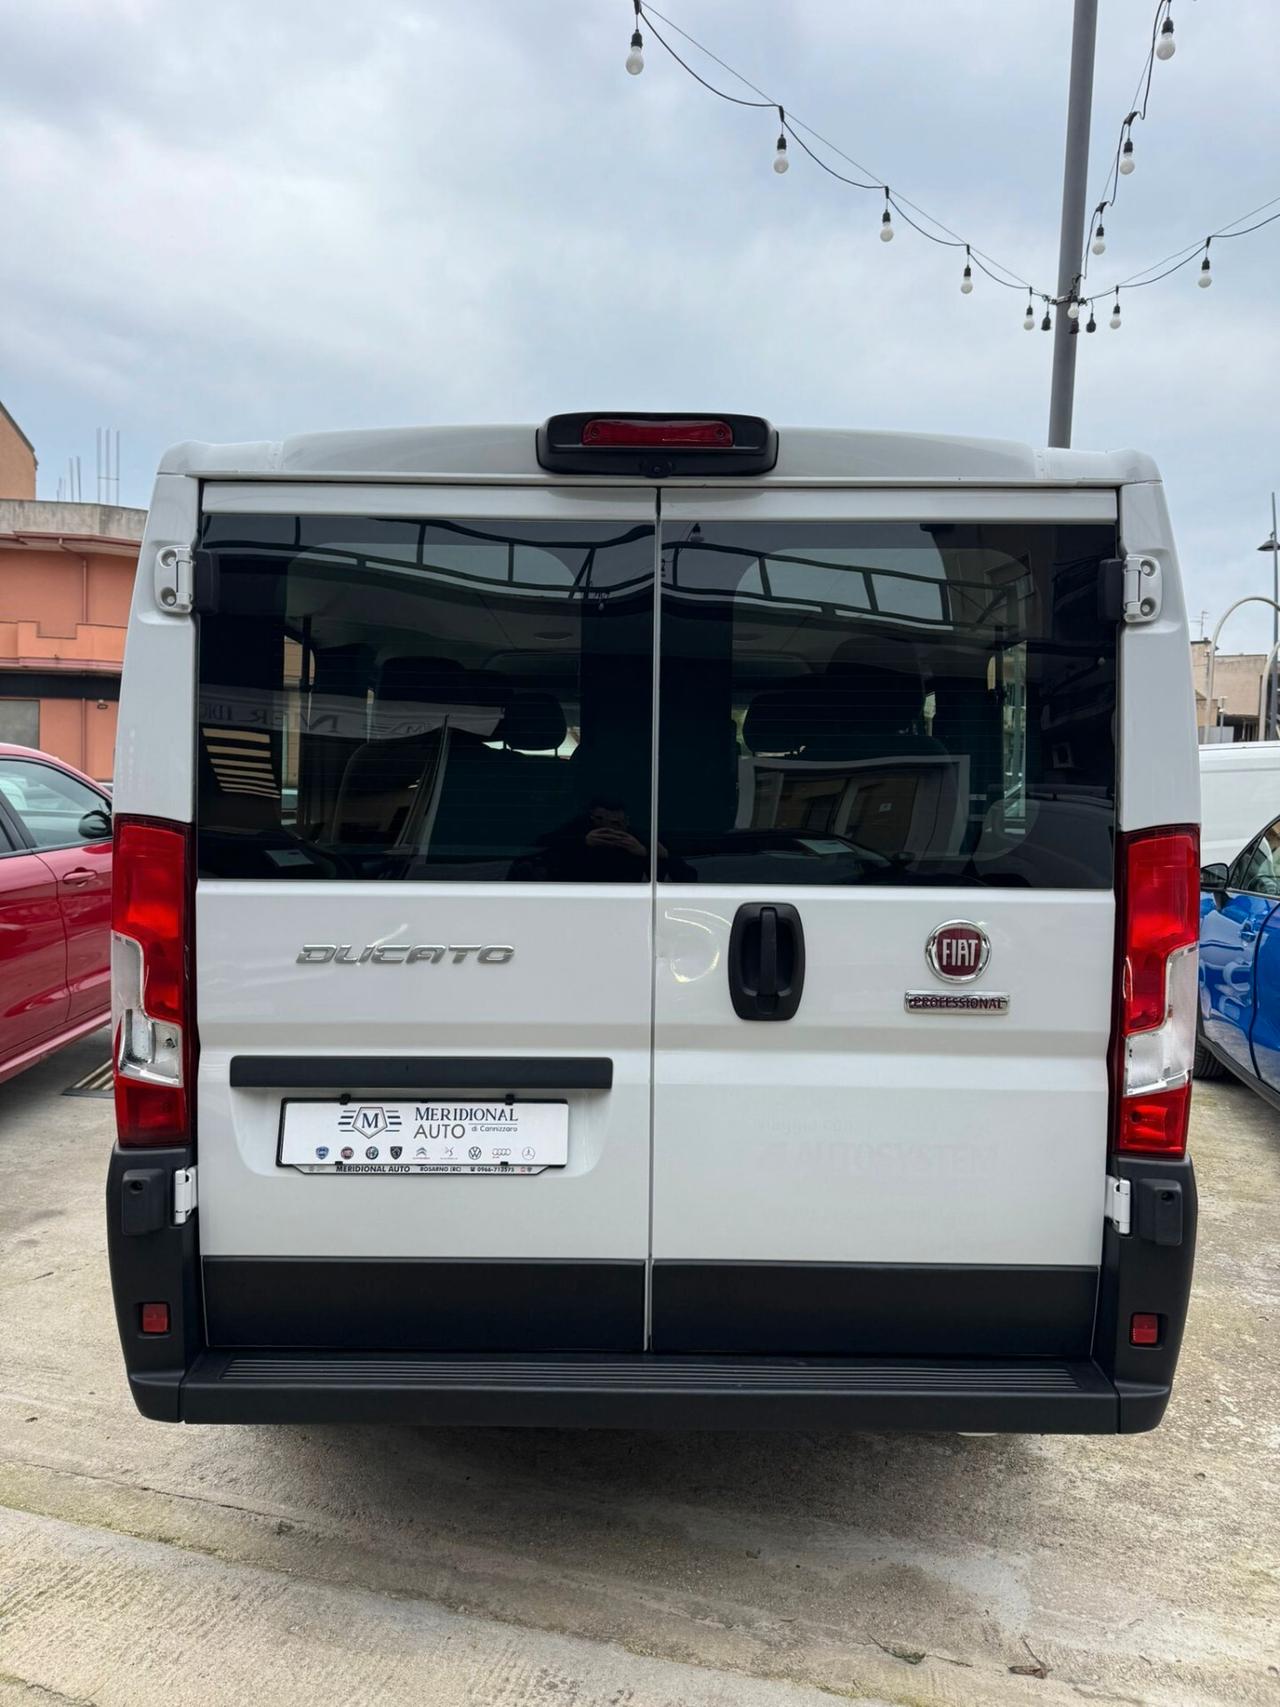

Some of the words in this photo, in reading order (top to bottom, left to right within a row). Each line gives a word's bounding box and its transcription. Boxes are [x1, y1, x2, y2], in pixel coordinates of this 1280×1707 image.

[295, 944, 515, 964] DUCATO
[942, 939, 979, 966] FIAT
[912, 996, 1003, 1009] PROFESSIONAL
[361, 1112, 380, 1129] M
[414, 1106, 519, 1121] MERIDIONAL
[413, 1123, 466, 1139] AUTO
[480, 1125, 519, 1133] Cannizzaro
[335, 1164, 387, 1173] MERIDIONAL
[388, 1164, 411, 1173] AUTO
